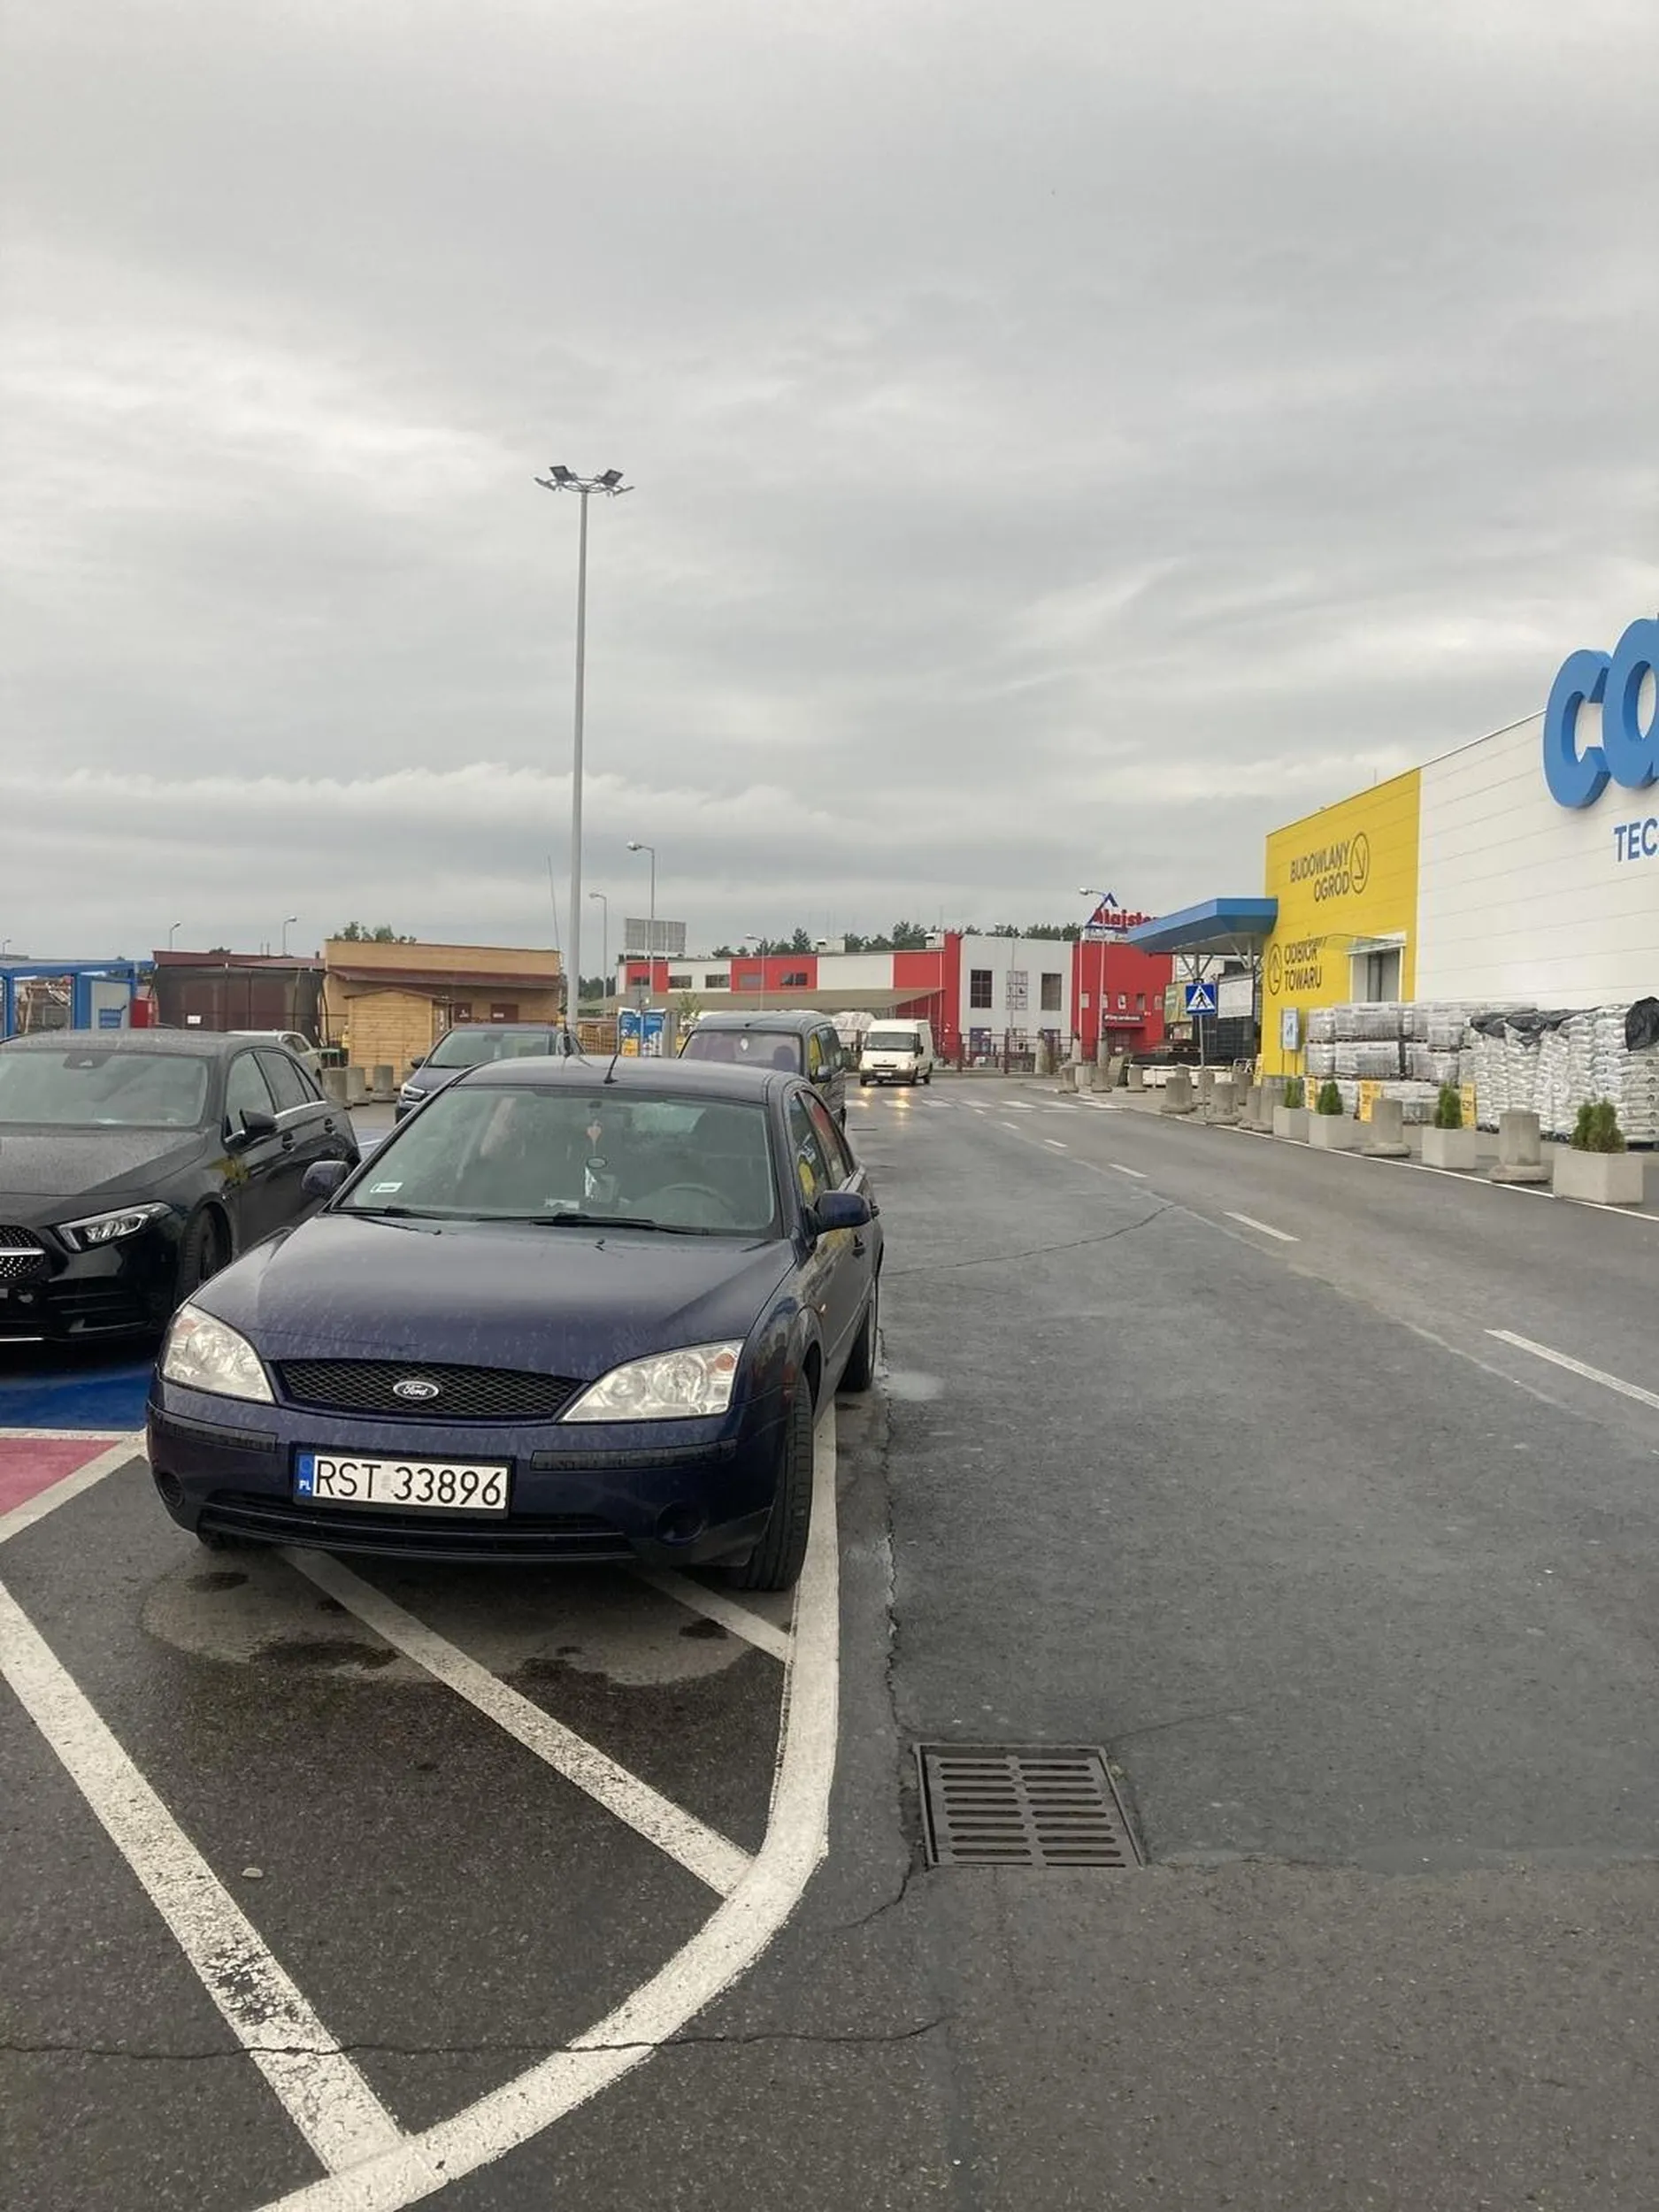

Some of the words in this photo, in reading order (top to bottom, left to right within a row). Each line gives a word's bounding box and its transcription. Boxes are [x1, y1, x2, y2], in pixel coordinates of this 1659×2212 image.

[1289, 840, 1350, 883] BUDOWLANY
[1284, 965, 1323, 992] TOWARU
[400, 1383, 431, 1398] Ford
[298, 1479, 311, 1491] PL
[316, 1460, 381, 1499] RST
[393, 1466, 502, 1506] 33896
